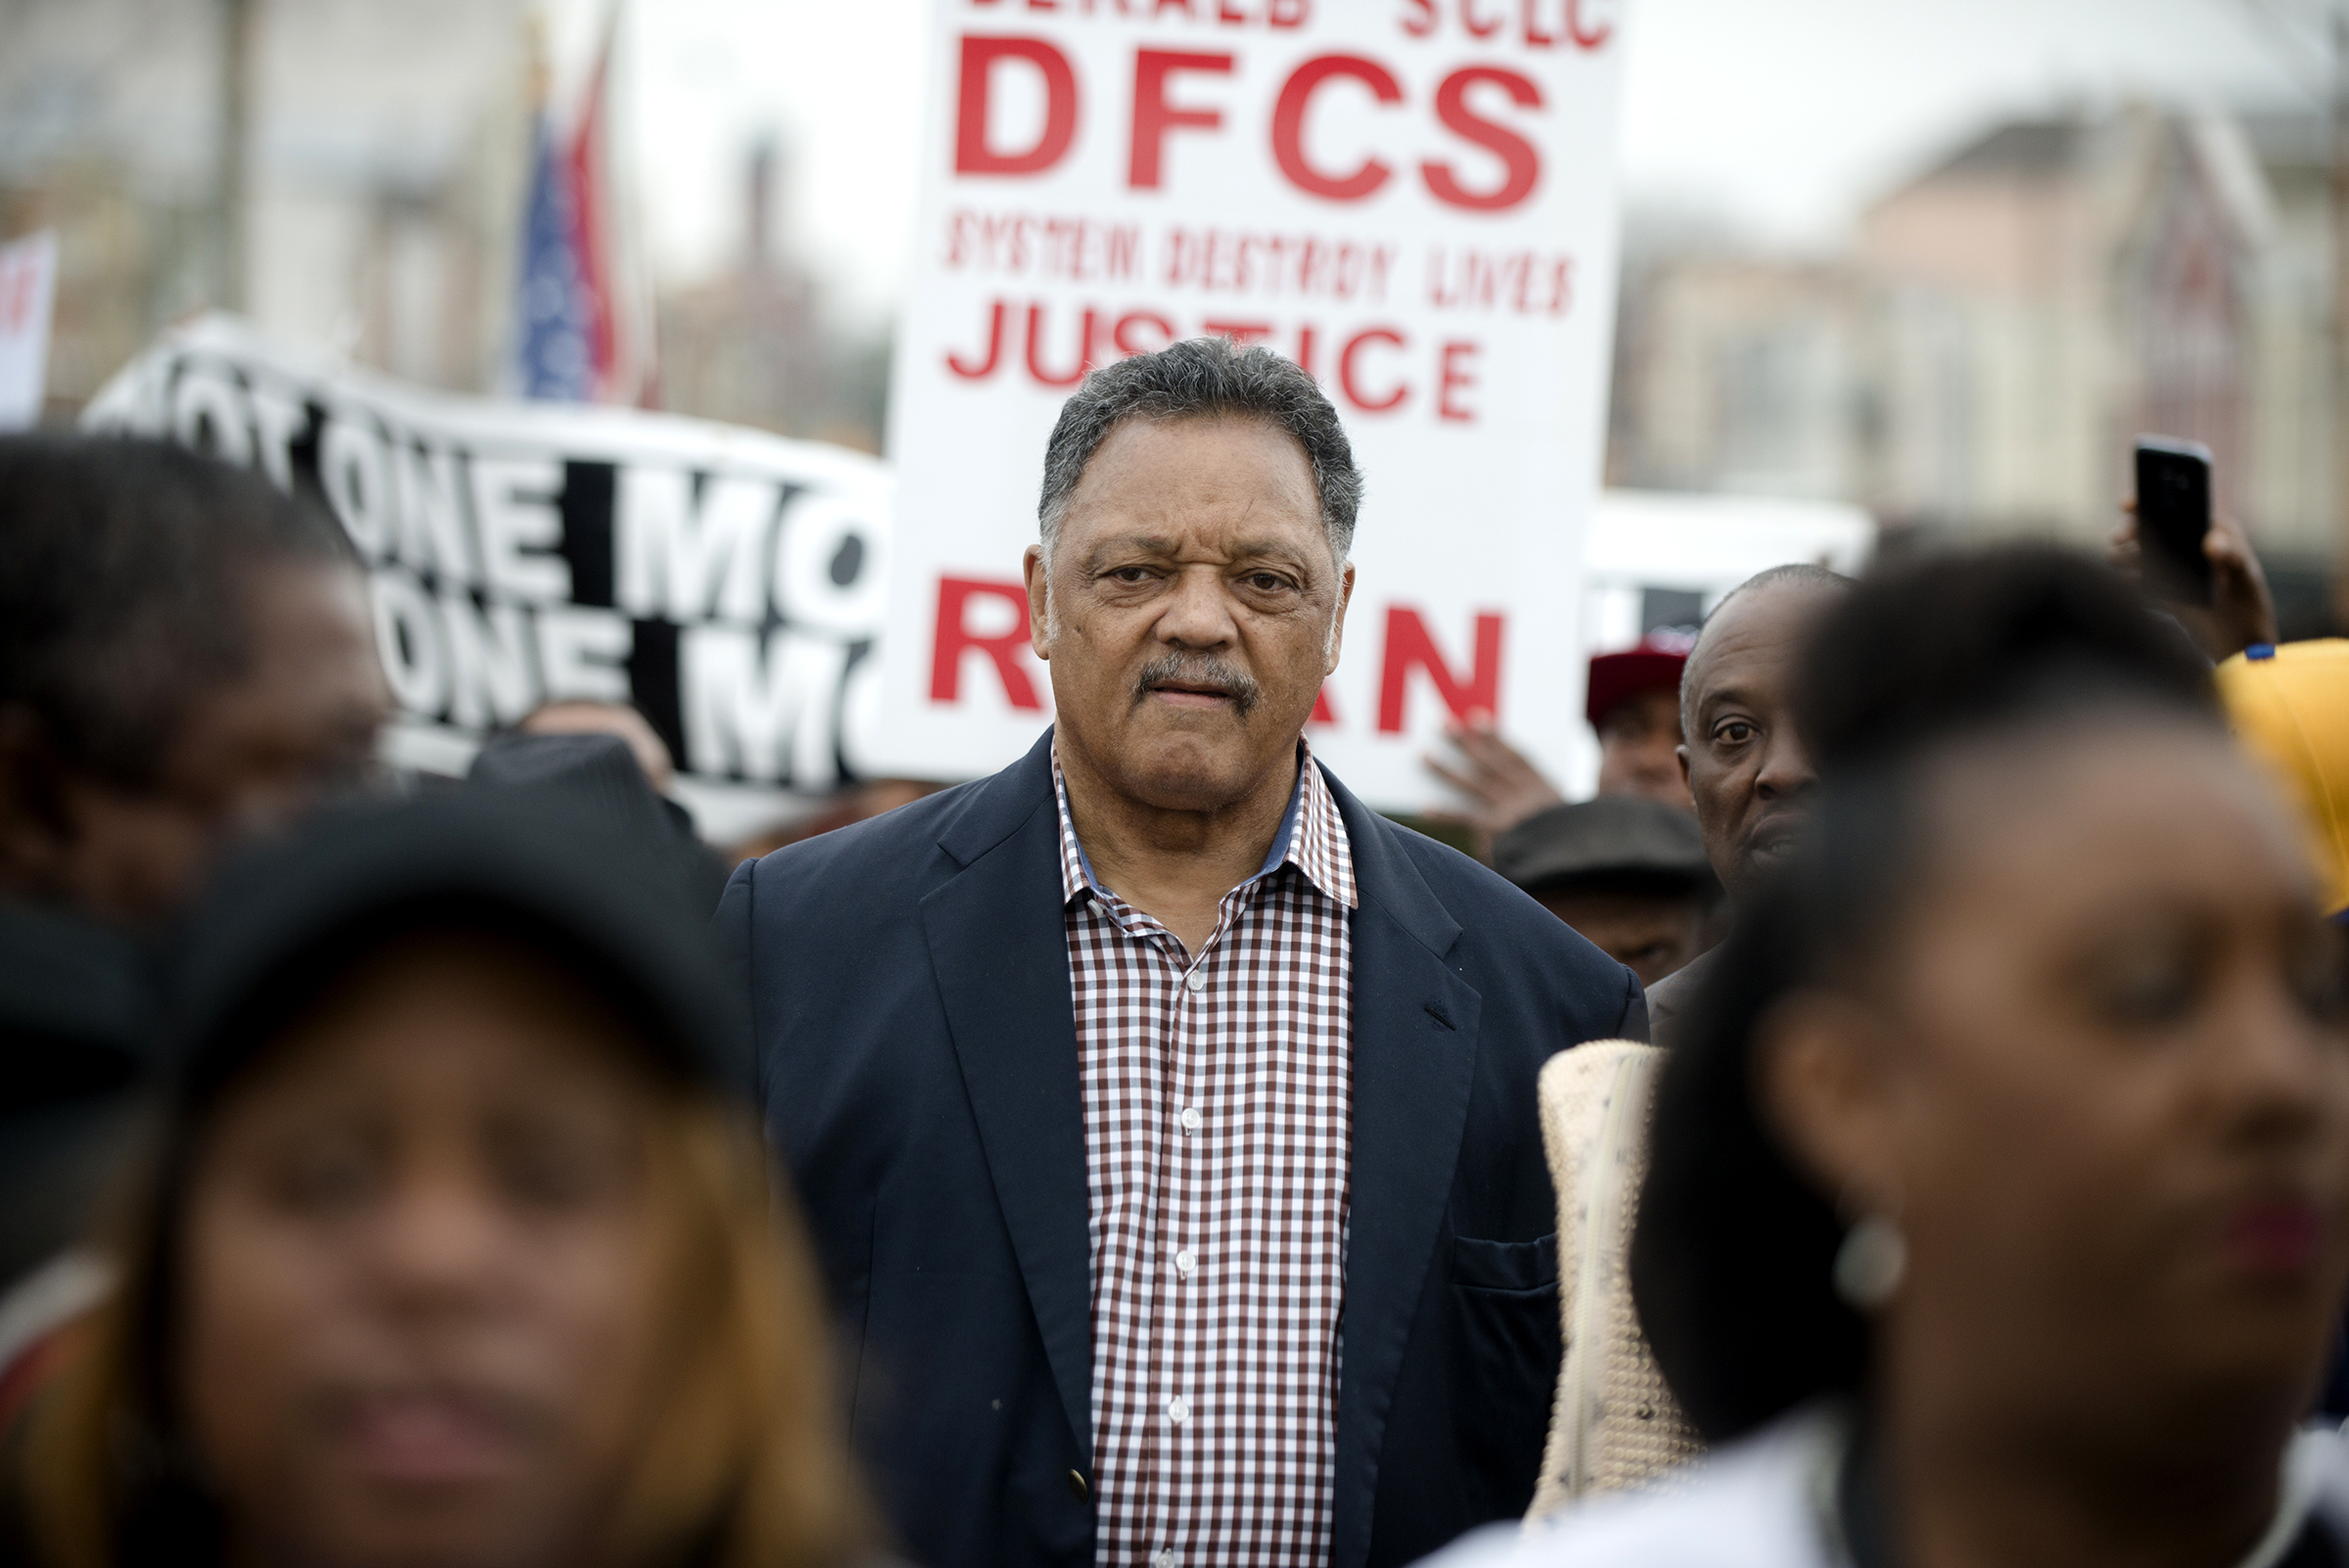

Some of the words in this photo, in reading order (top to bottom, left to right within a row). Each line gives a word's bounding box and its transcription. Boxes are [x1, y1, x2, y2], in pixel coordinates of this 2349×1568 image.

[953, 35, 1546, 211] DFCS
[1167, 227, 1398, 303] DESTROY
[1429, 247, 1578, 317] LIVES
[317, 415, 574, 603] ONE
[370, 570, 634, 724] ONE
